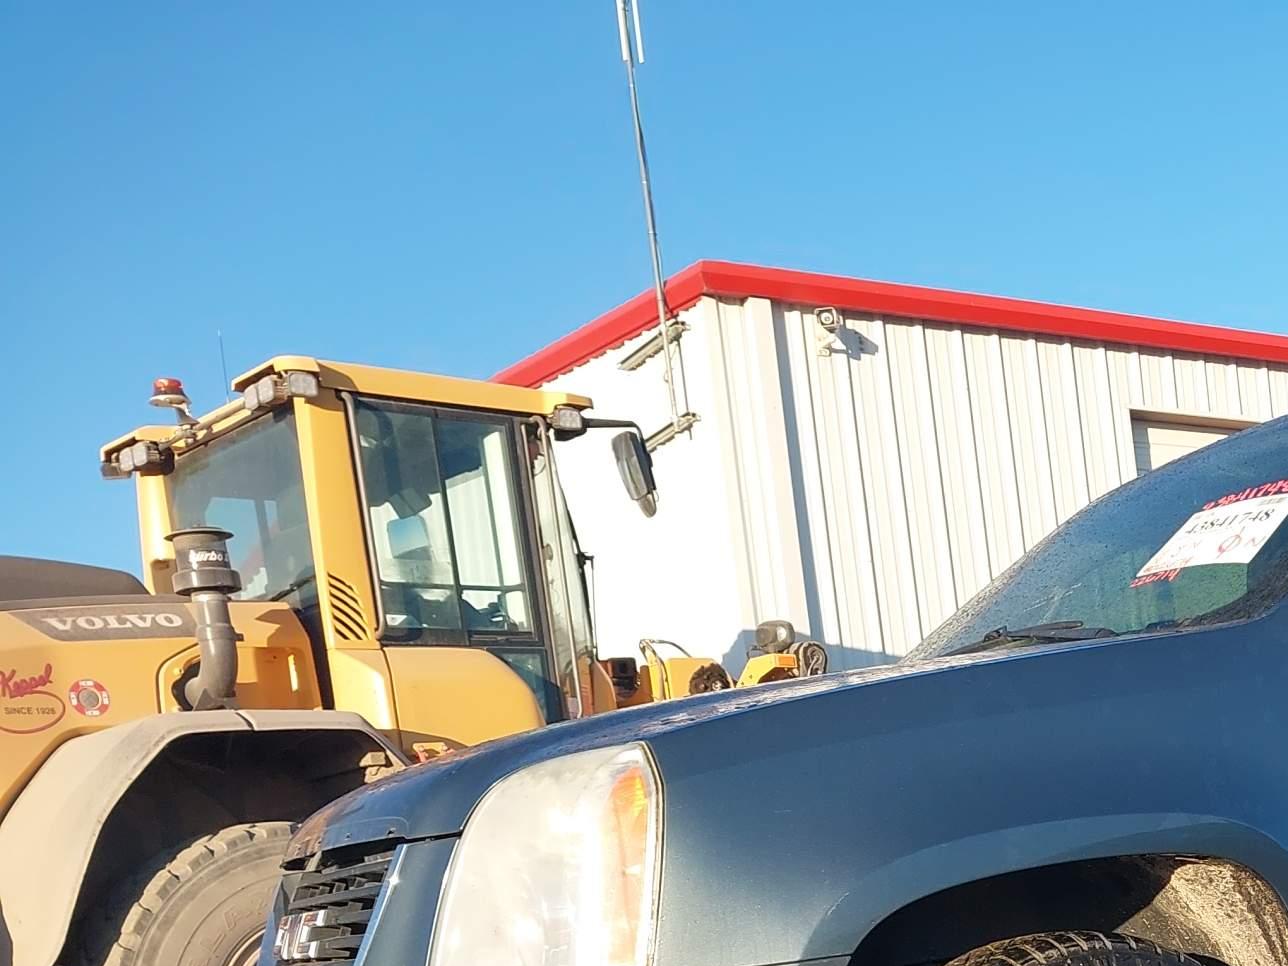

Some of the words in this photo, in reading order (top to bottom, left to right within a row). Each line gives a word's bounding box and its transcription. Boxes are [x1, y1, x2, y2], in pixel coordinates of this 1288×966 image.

[1185, 508, 1275, 534] 43841748
[43, 611, 183, 632] VOLVO
[4, 706, 33, 715] SINCE
